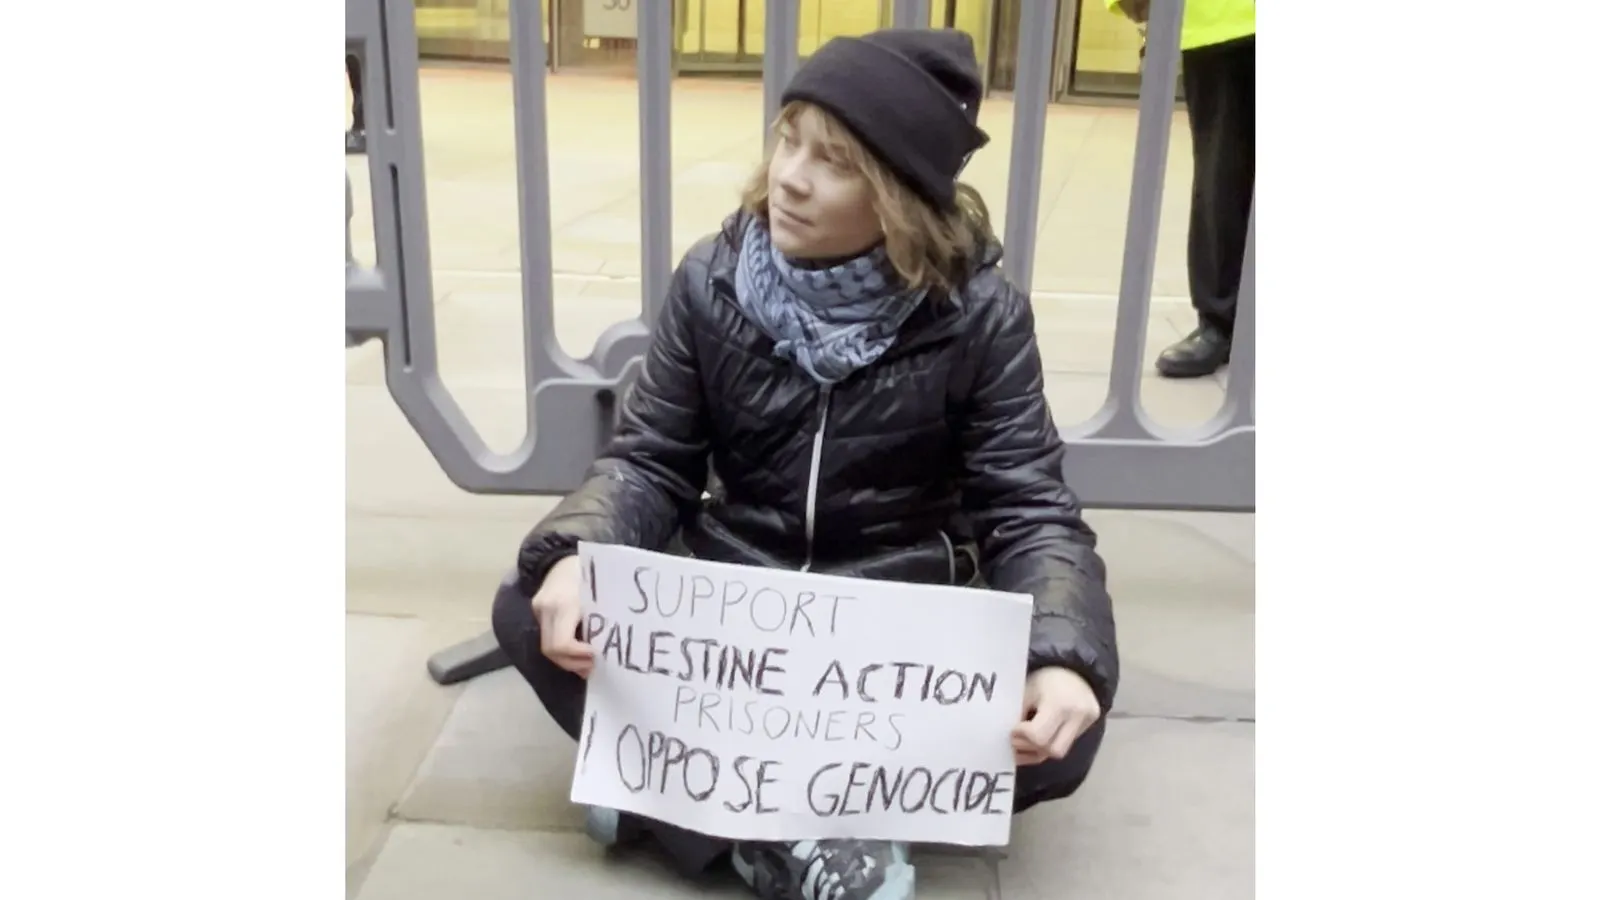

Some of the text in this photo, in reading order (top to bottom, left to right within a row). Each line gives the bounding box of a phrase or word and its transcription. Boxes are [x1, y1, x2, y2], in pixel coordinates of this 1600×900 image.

[588, 555, 857, 637] I SUPPORT
[586, 613, 997, 705] PALESTINE ACTION
[673, 686, 905, 751] PRISONERS
[582, 710, 1014, 817] I OPPOSE GENOCIDE
